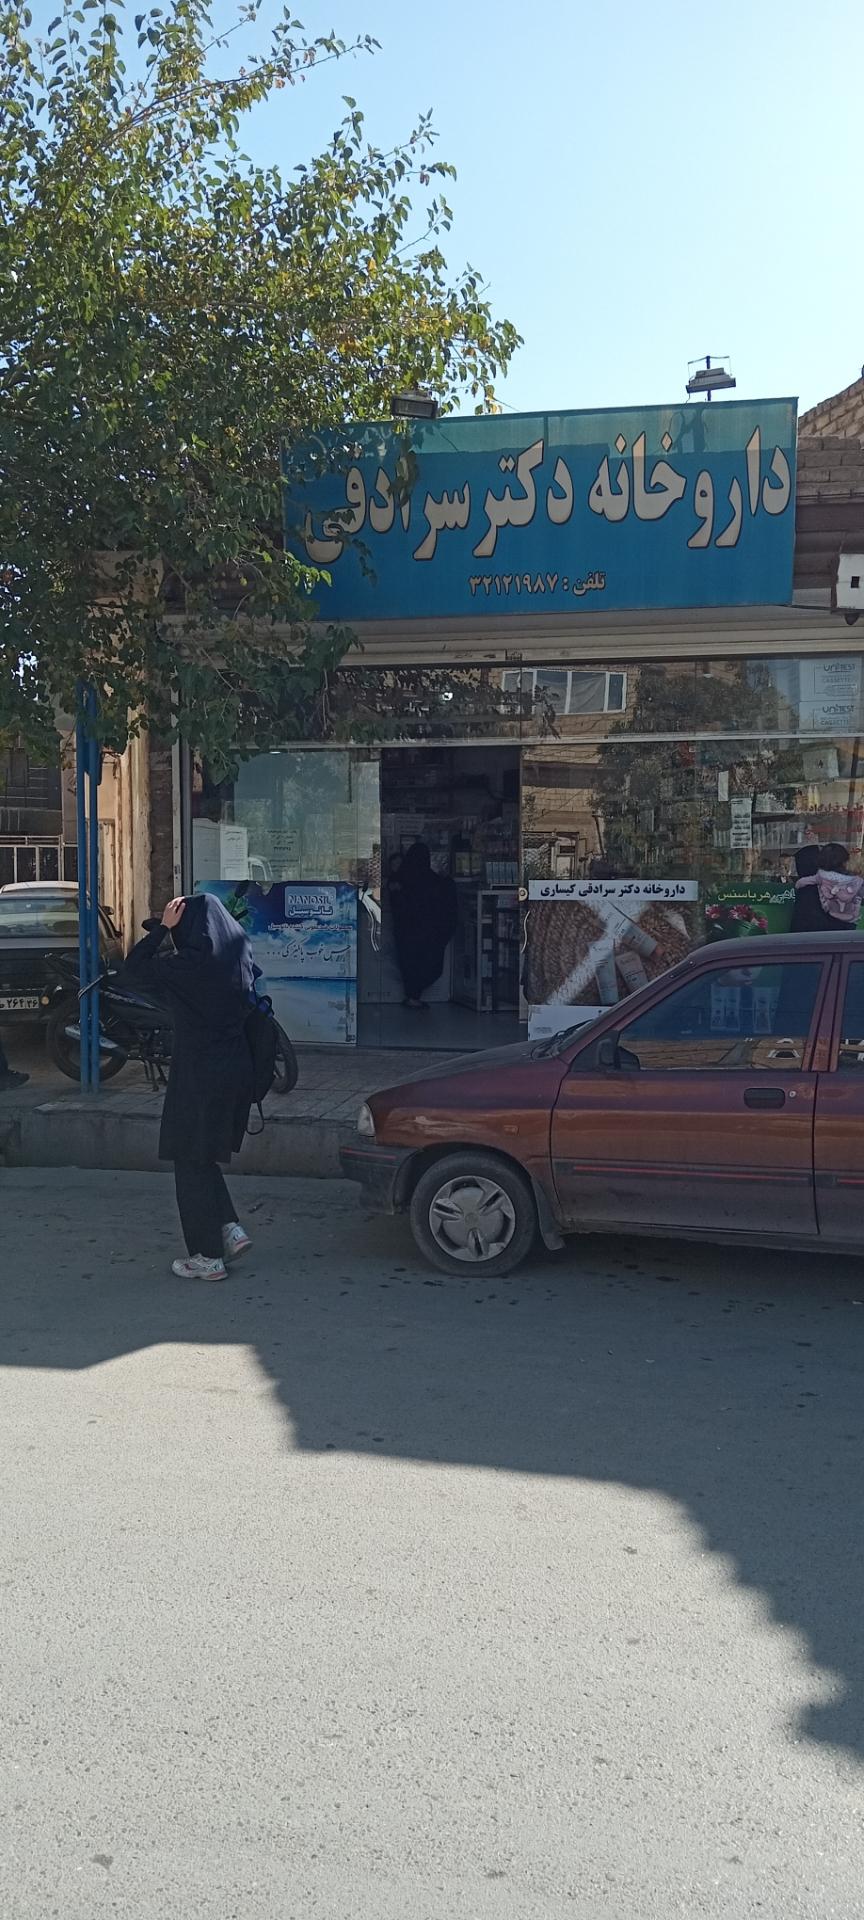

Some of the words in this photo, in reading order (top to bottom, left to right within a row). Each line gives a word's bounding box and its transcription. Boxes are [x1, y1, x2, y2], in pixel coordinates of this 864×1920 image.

[588, 424, 792, 549] داروخانه
[472, 438, 575, 558] دکتر
[468, 572, 559, 597] ۳۲۱۲۱۹۸۷
[573, 570, 607, 596] تلفن
[540, 883, 576, 897] کیساری
[578, 882, 616, 898] سرادقی
[617, 884, 641, 898] دکتر
[642, 884, 686, 898] داروخانه
[288, 894, 332, 905] NANOSIL
